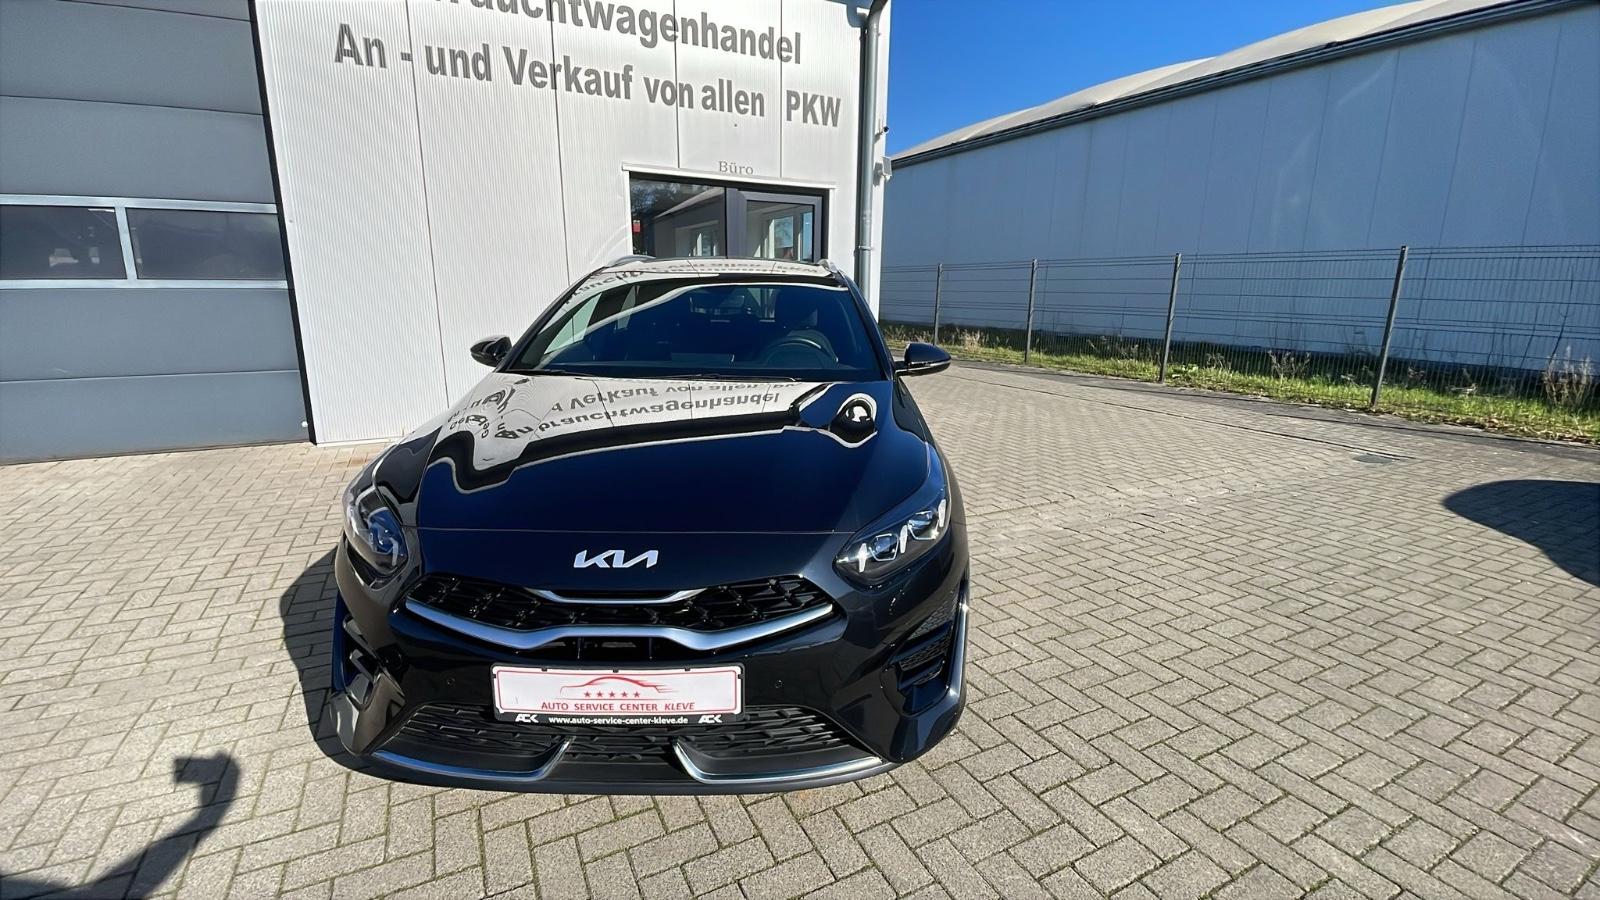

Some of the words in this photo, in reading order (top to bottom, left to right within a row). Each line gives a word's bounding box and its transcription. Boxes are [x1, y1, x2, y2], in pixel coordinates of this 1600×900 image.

[448, 0, 801, 64] chtwagenhandel
[334, 23, 388, 69] An
[424, 43, 492, 82] und
[502, 46, 633, 100] Verkauf
[643, 76, 694, 109] von
[701, 78, 765, 117] allen
[786, 89, 841, 127] PKW
[718, 160, 754, 176] Büro
[541, 702, 569, 710] AUTO
[574, 703, 614, 711] SERVICE
[620, 703, 658, 711] CENTER
[664, 702, 695, 711] KLEVE
[548, 716, 689, 725] www.auto-service-center-kleve.de
